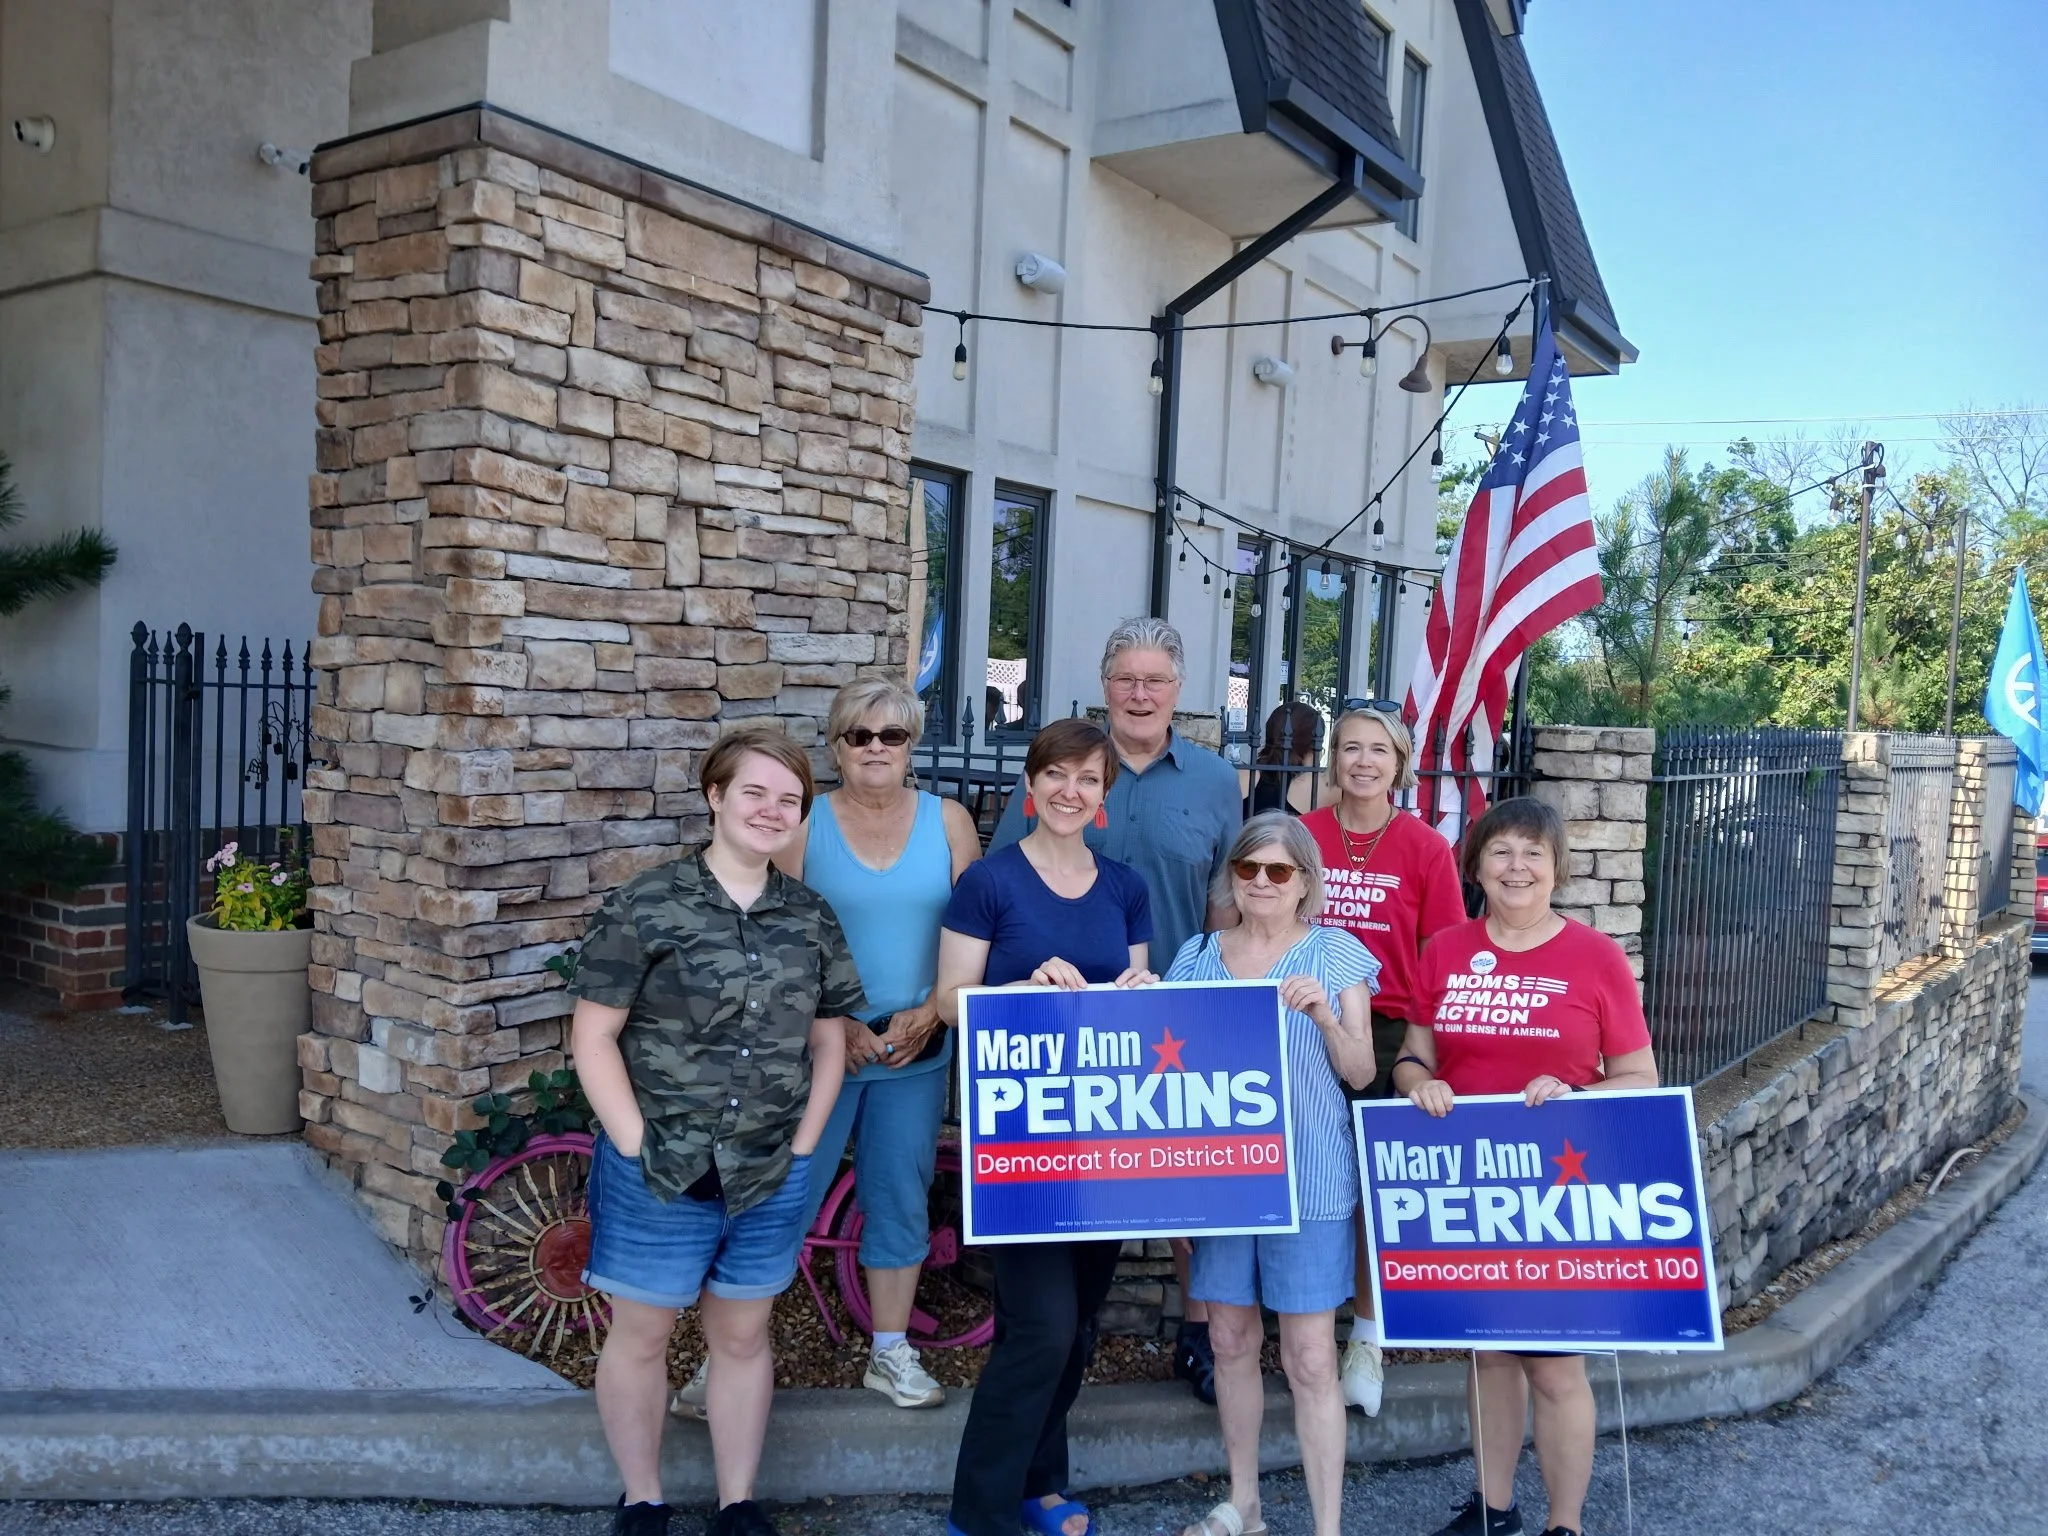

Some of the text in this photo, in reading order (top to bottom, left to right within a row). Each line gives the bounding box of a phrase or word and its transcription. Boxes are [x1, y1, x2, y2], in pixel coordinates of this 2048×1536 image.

[1321, 867, 1363, 885] OMS
[1324, 884, 1387, 903] MAND
[1323, 900, 1371, 919] TION
[1323, 917, 1347, 927] SENSE
[1348, 920, 1356, 928] IN
[1357, 921, 1391, 932] AMERICA
[1446, 973, 1521, 991] MOMS
[1442, 990, 1549, 1008] DEMAND
[1435, 1005, 1530, 1025] ACTION
[1445, 1023, 1462, 1033] GUN
[1465, 1024, 1497, 1035] SENSE
[1500, 1026, 1510, 1036] IN
[1512, 1027, 1560, 1038] AMERICA
[976, 1026, 1142, 1075] Mary Ann
[975, 1069, 1278, 1136] PERKINS
[977, 1143, 1280, 1174] Democrat for District 100
[1373, 1138, 1543, 1186] Mary Ann
[1376, 1182, 1693, 1244] PERKINS
[1384, 1257, 1699, 1281] Democrat for District 100
